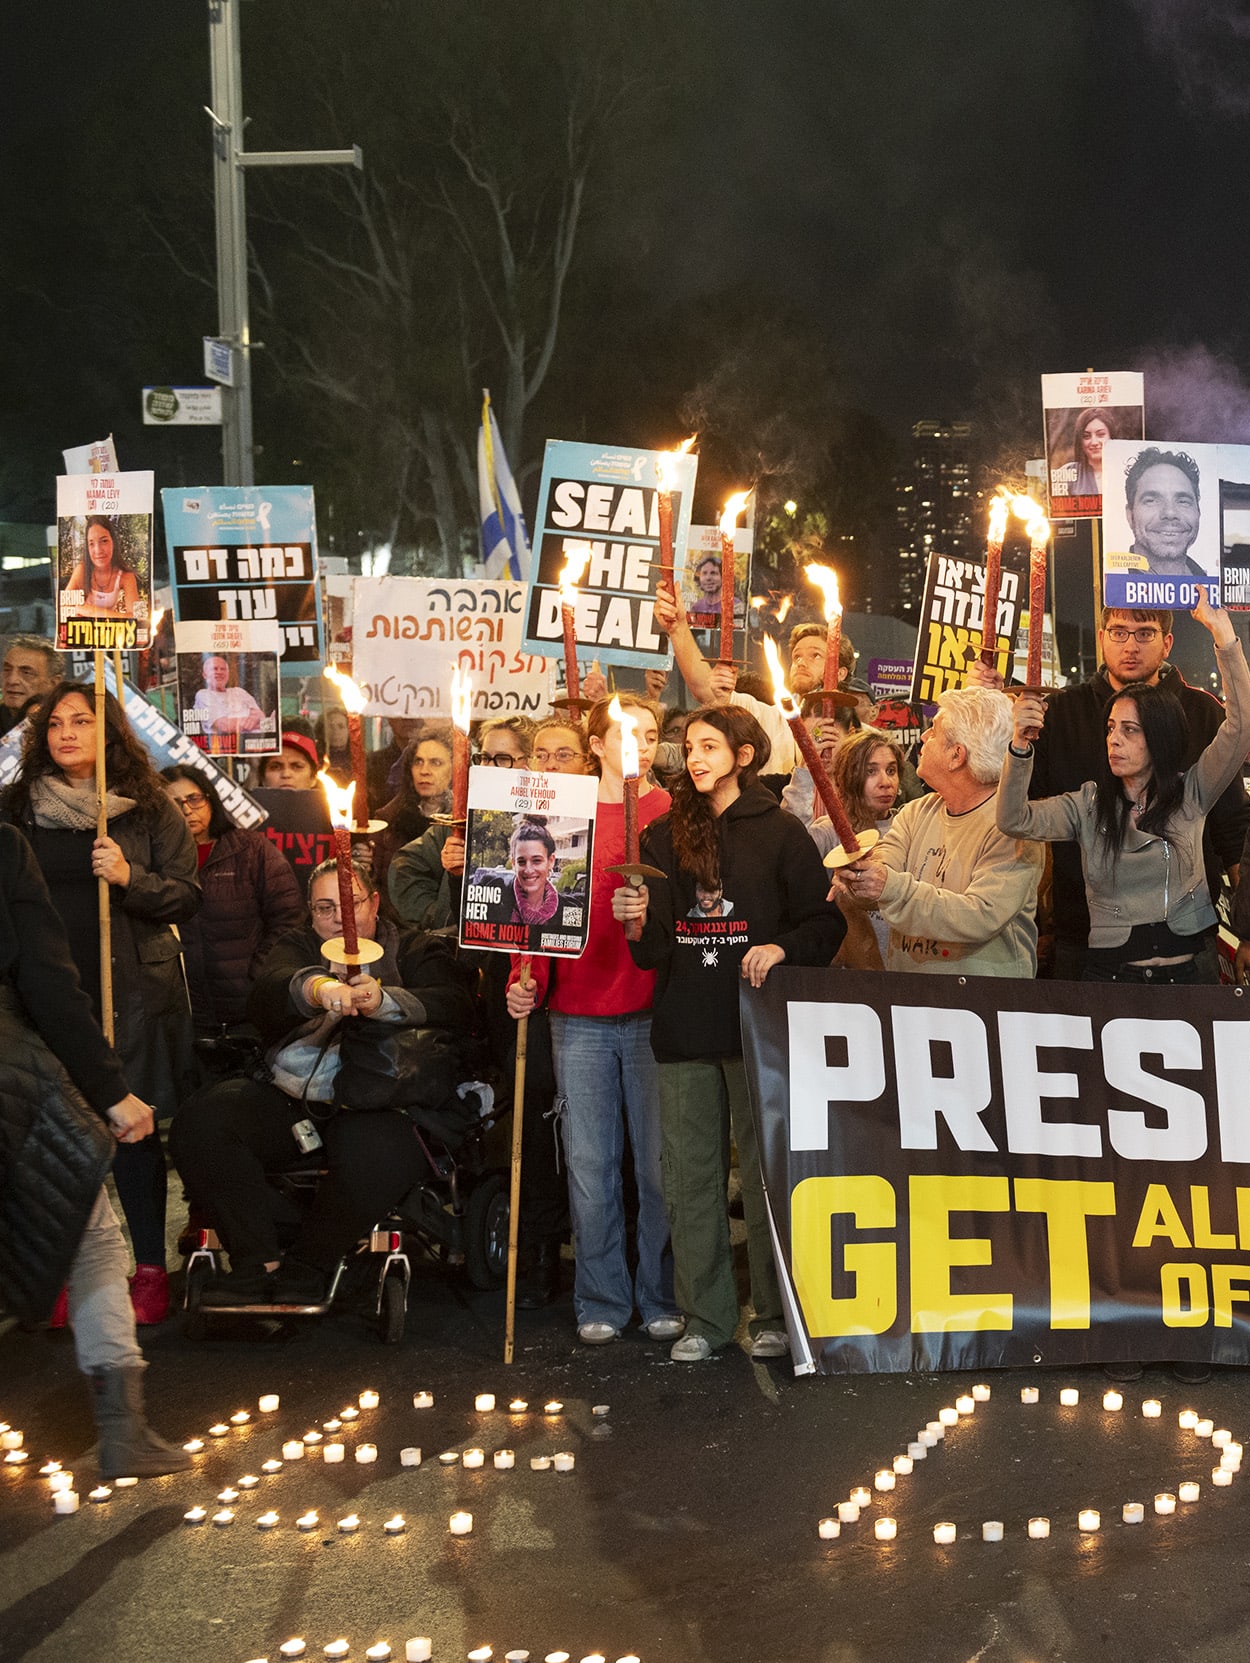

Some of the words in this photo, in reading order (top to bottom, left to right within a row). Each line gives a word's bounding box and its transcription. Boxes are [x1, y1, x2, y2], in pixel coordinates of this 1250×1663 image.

[1051, 469, 1077, 483] BRING
[107, 489, 120, 498] LEVY
[1052, 483, 1069, 496] HER
[183, 549, 229, 581] דם
[237, 547, 304, 579] כמה
[937, 557, 1019, 601] תציאו
[60, 590, 85, 606] BRING
[426, 588, 522, 613] אהבה
[1126, 582, 1175, 604] BRING
[1224, 586, 1246, 603] HIM
[218, 588, 277, 620] עוד
[366, 614, 503, 642] והשותפות
[536, 589, 661, 650] DEAL
[470, 690, 541, 711] מהפח
[125, 695, 177, 748] כולם
[183, 709, 208, 721] BRING
[183, 722, 200, 735] HIM
[510, 786, 529, 797] ARBEL
[530, 787, 556, 799] YEHOUD
[215, 779, 263, 829] כולם
[515, 799, 532, 809] (29)
[259, 827, 338, 865] הציל
[467, 885, 501, 904] BRING
[465, 903, 488, 920] HER
[464, 921, 496, 940] HOME
[498, 924, 529, 943] NOW!
[729, 920, 748, 935] מתן
[676, 936, 710, 946] לאוקטובר
[711, 936, 725, 944] ב-7
[726, 936, 748, 946] נחטף
[790, 1175, 1116, 1338] GET
